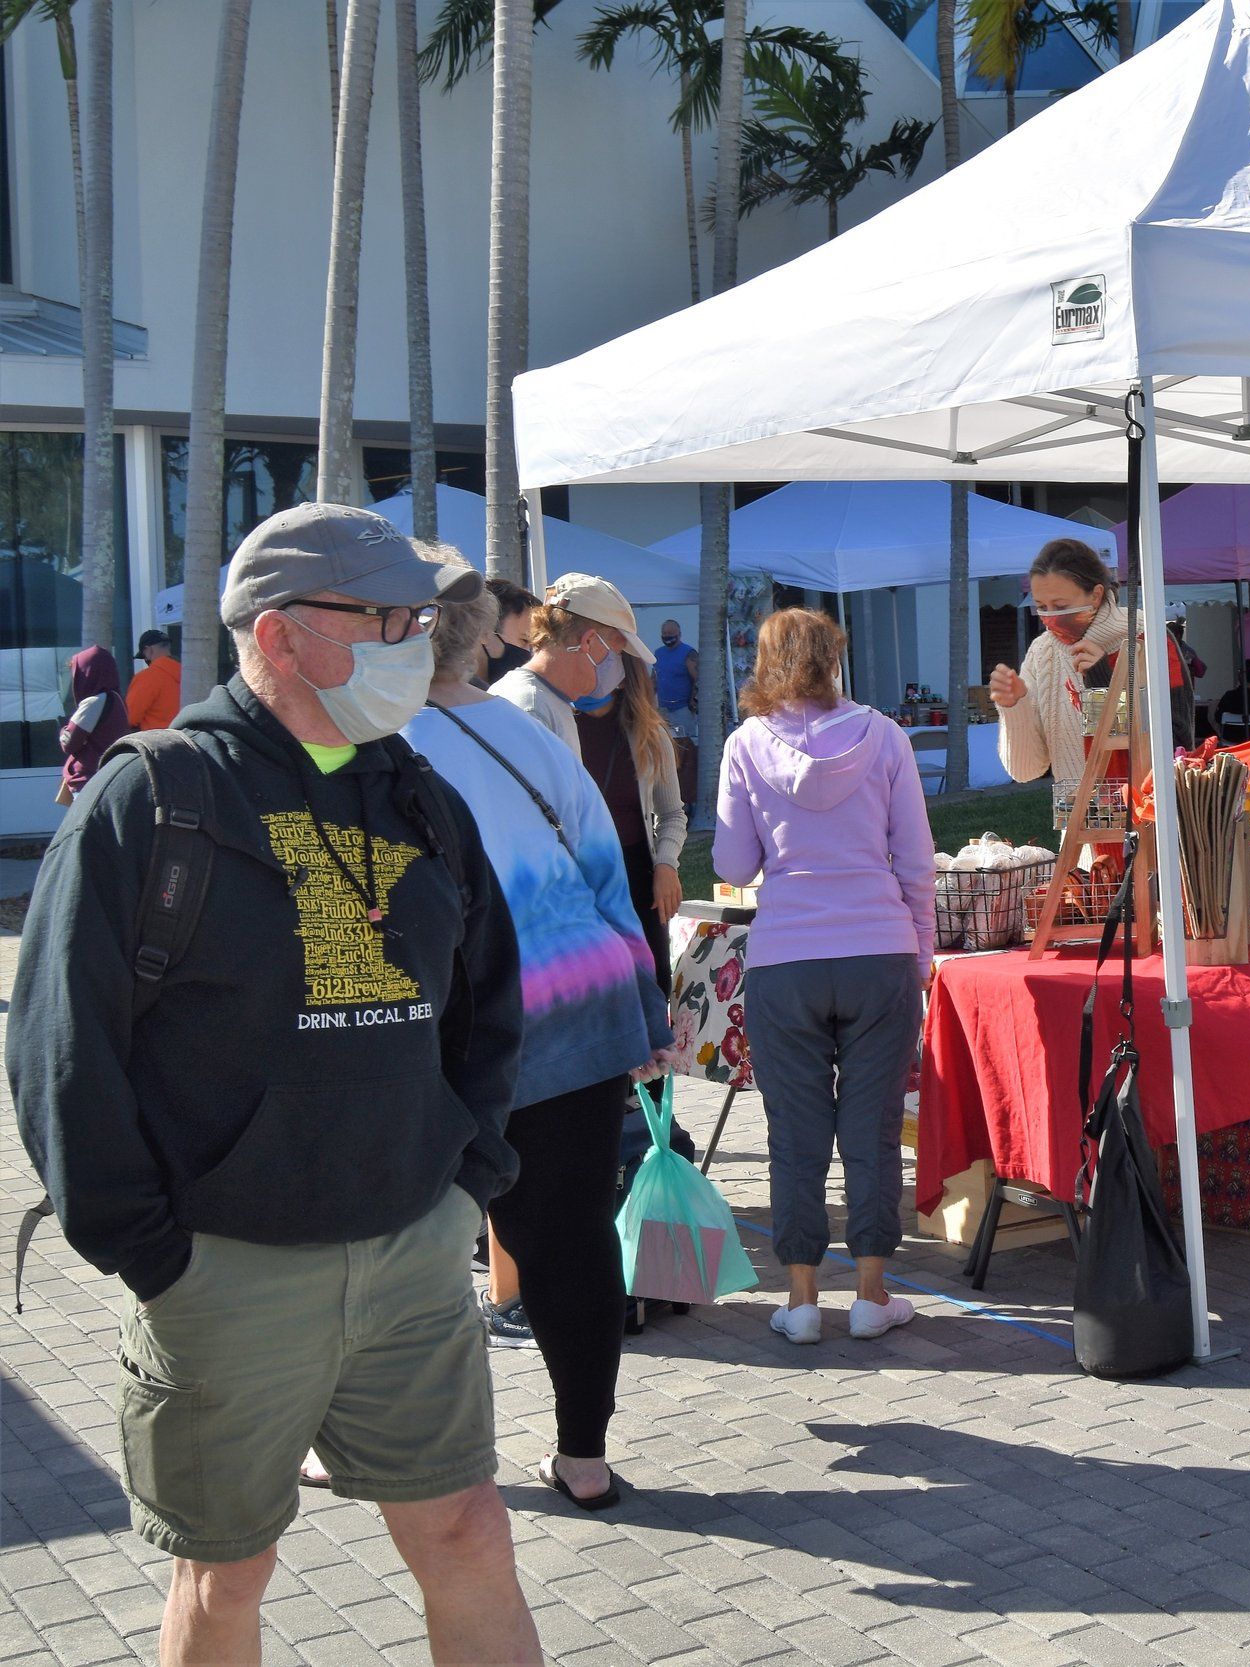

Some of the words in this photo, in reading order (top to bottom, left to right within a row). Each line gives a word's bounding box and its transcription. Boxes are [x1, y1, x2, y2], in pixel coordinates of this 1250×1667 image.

[1055, 305, 1100, 329] Eurmax
[336, 943, 373, 964] Luc!d
[297, 1012, 351, 1029] DRINK.
[355, 1007, 405, 1026] LOCAL.
